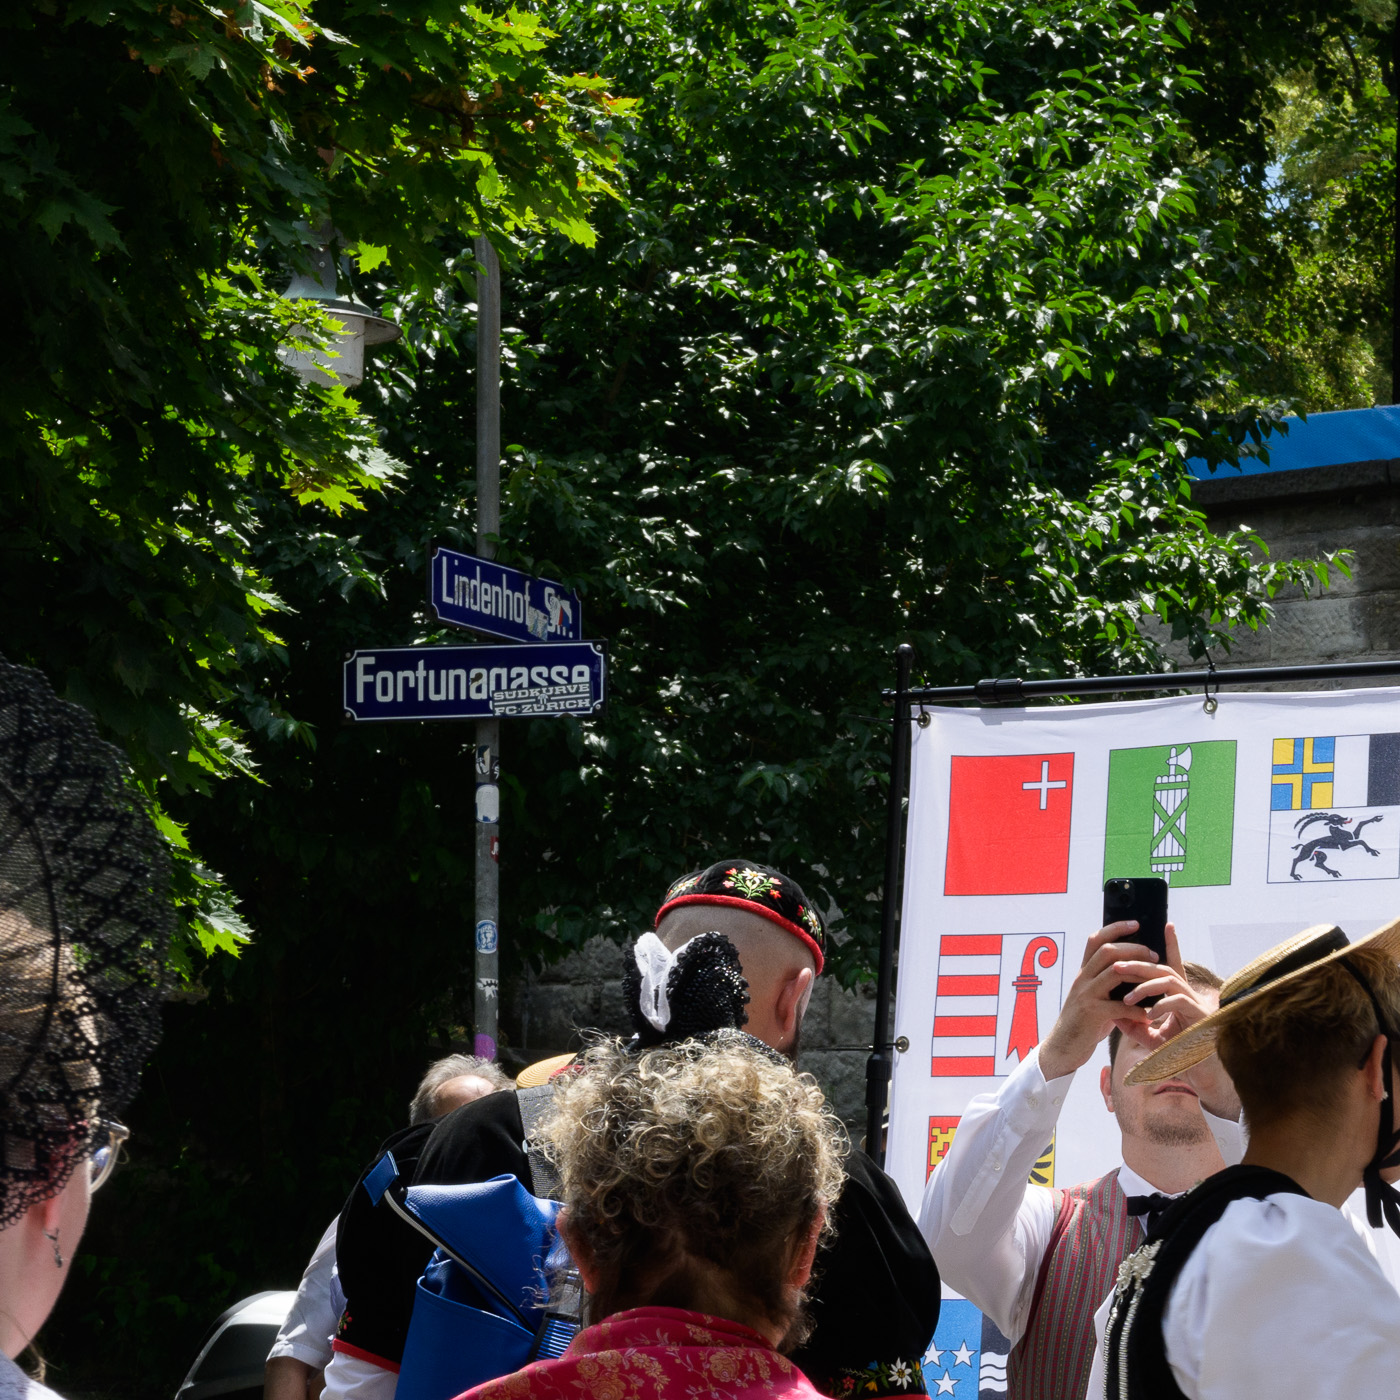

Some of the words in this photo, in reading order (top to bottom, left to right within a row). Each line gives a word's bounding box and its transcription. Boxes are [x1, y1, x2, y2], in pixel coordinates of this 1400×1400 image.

[442, 556, 530, 625] Lindenhof
[356, 656, 590, 710] Fortunagasse
[493, 683, 590, 700] SÜDKURVE
